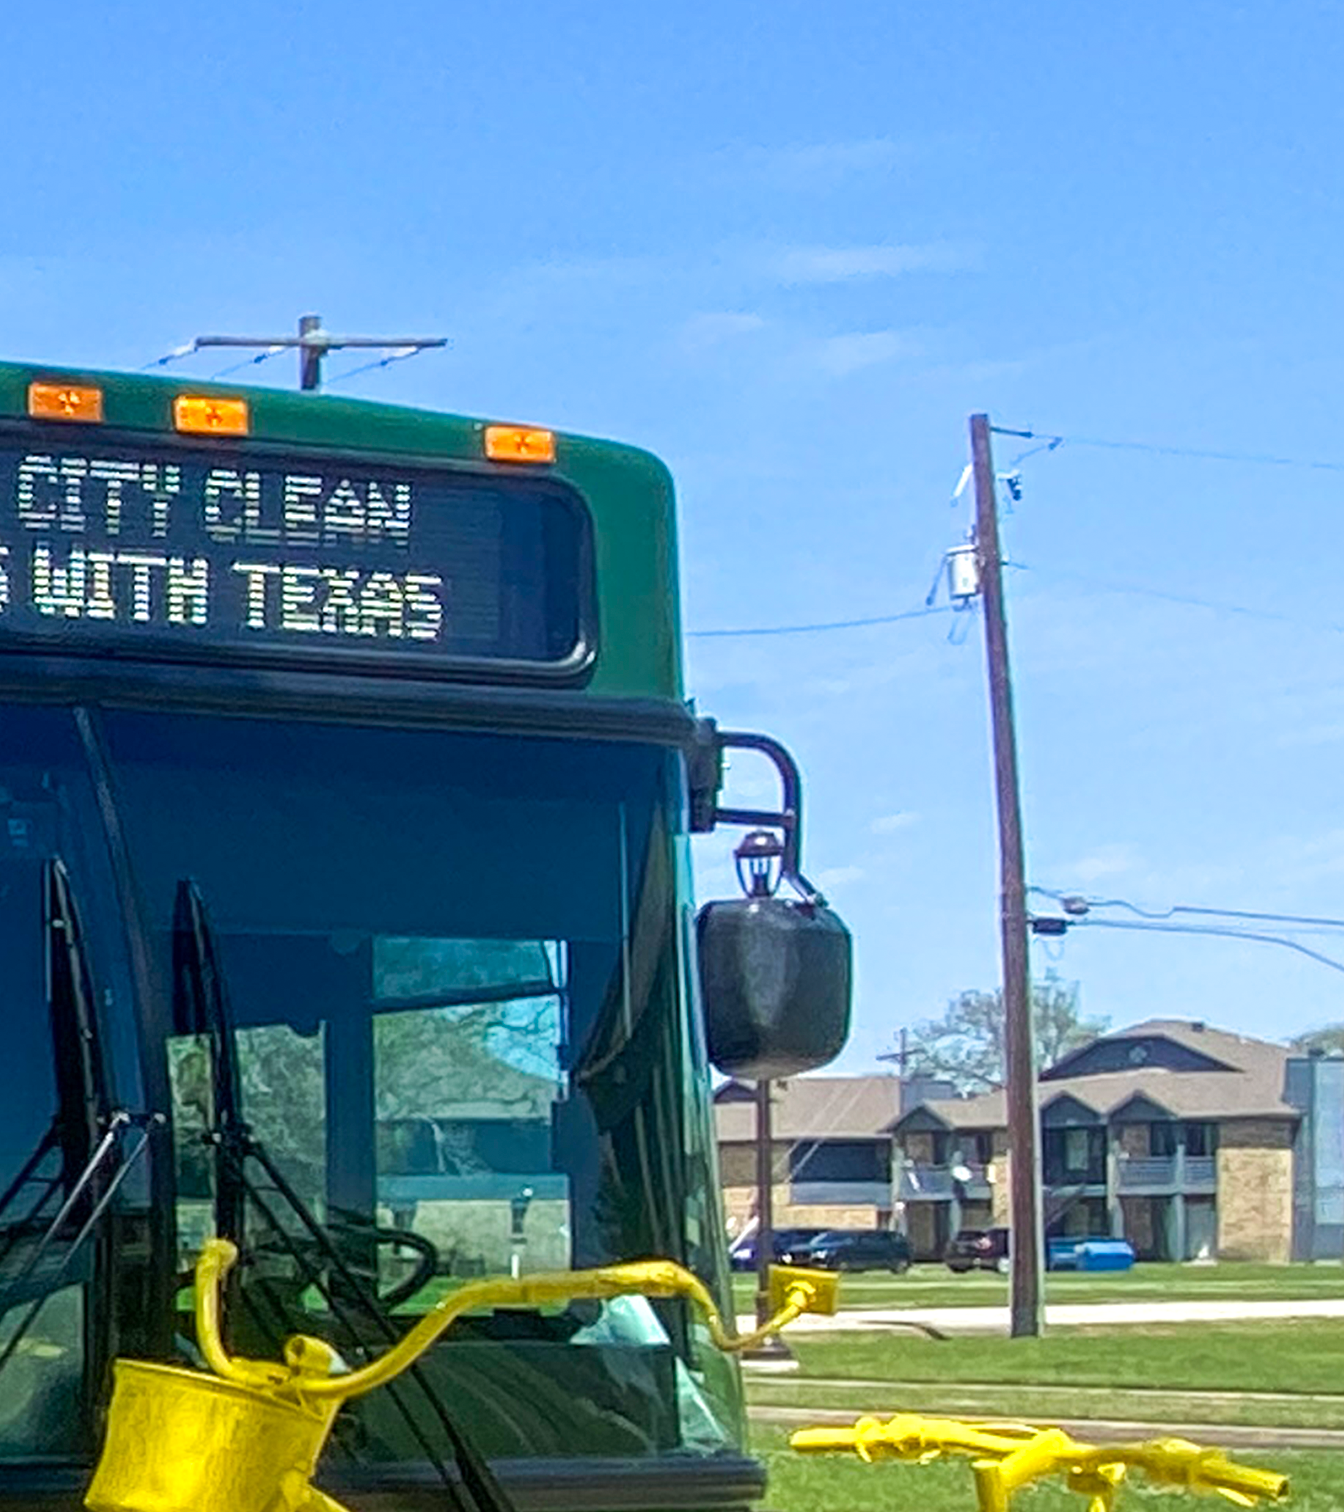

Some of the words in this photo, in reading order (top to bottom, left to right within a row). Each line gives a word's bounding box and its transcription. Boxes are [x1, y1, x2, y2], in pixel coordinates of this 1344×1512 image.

[18, 455, 181, 538] CITY
[205, 470, 411, 548] CLEAN
[33, 540, 209, 625] WITH
[232, 560, 442, 640] TEXAS
